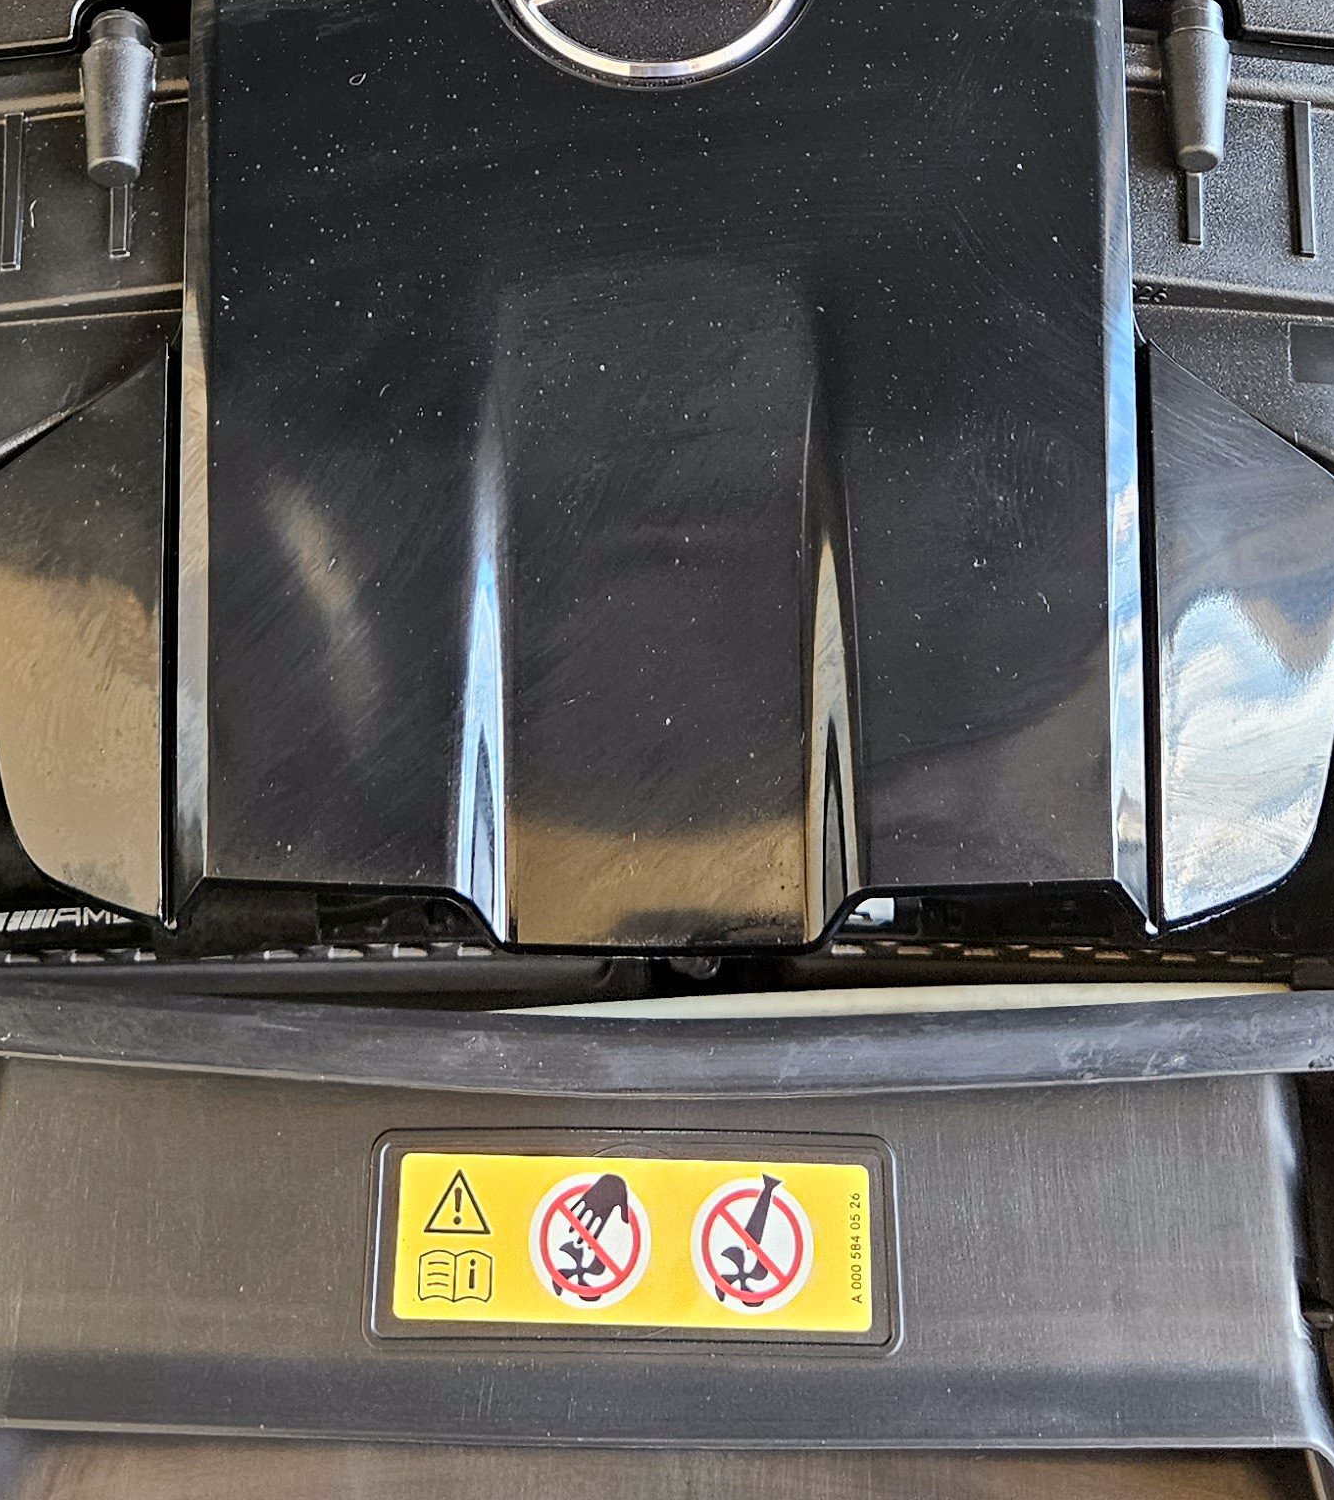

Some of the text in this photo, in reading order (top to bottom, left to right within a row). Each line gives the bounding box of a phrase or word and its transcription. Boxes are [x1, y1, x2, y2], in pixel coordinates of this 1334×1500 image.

[849, 1192, 863, 1304] A 000 584 05 26
